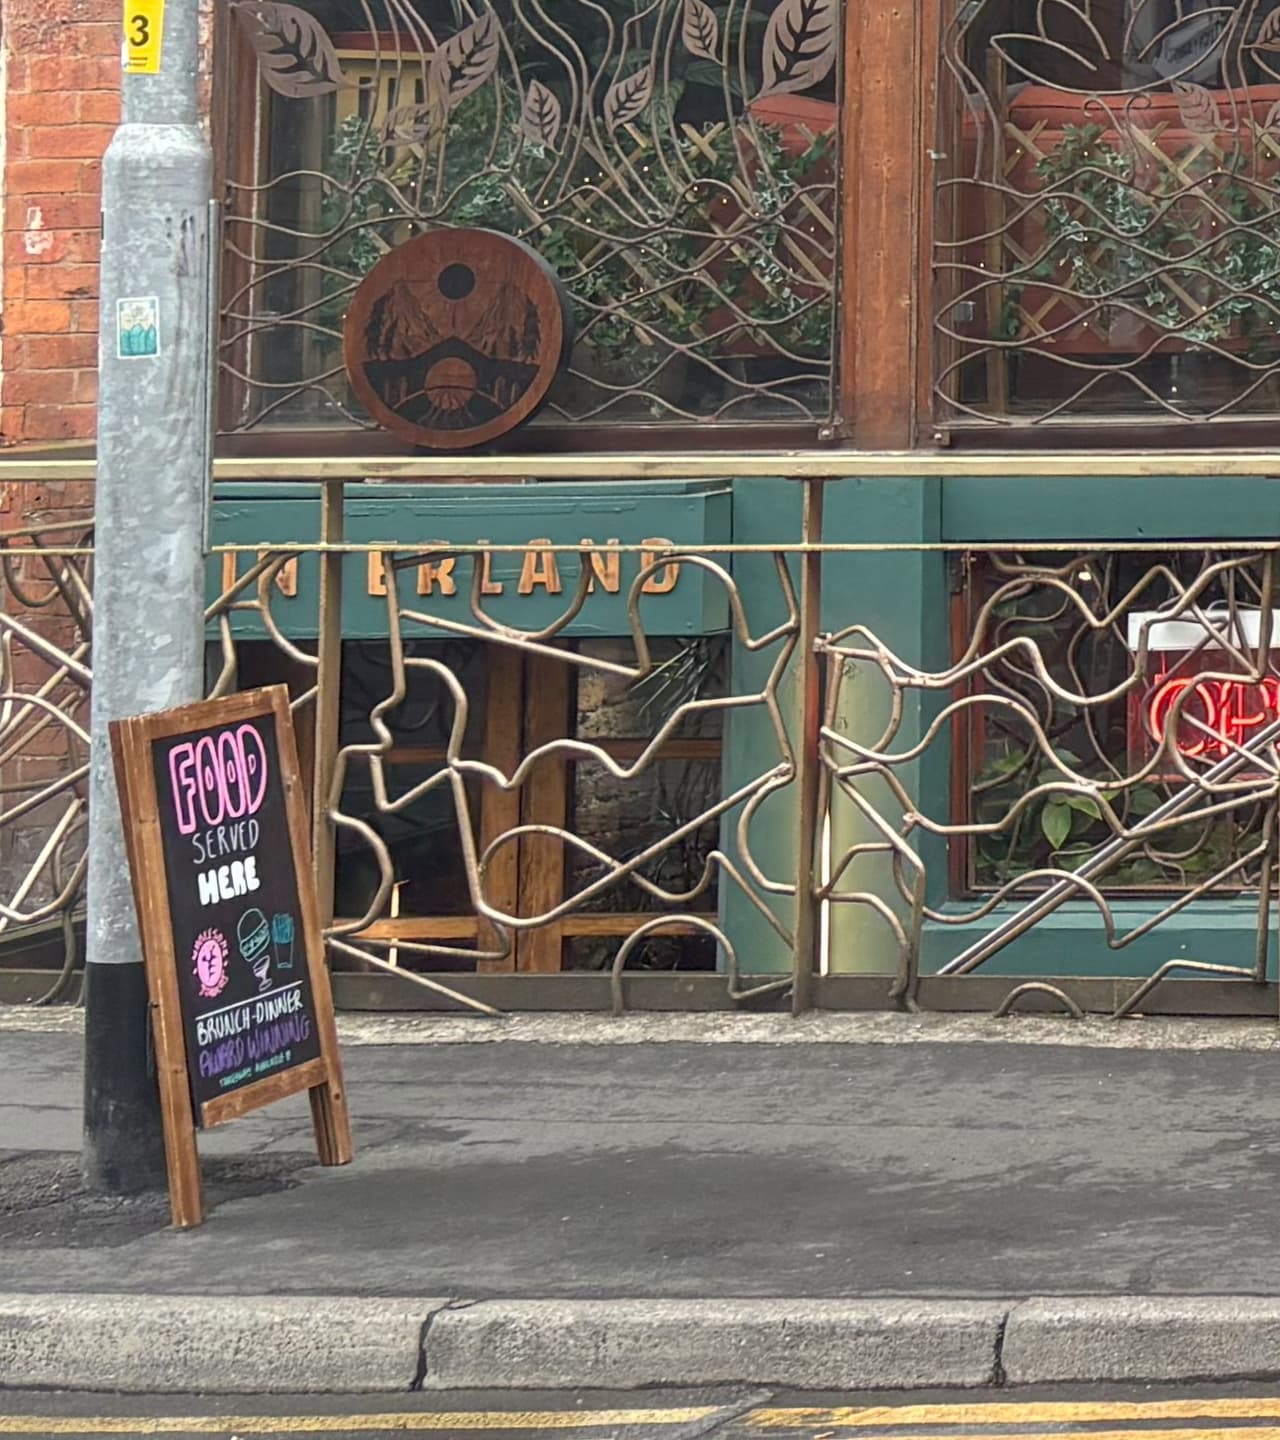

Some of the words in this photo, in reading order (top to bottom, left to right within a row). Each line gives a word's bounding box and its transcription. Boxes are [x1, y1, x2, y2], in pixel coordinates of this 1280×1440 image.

[222, 539, 681, 596] INERLAND
[169, 724, 267, 835] FOOD
[192, 819, 259, 864] SERVED
[198, 856, 260, 905] HERE
